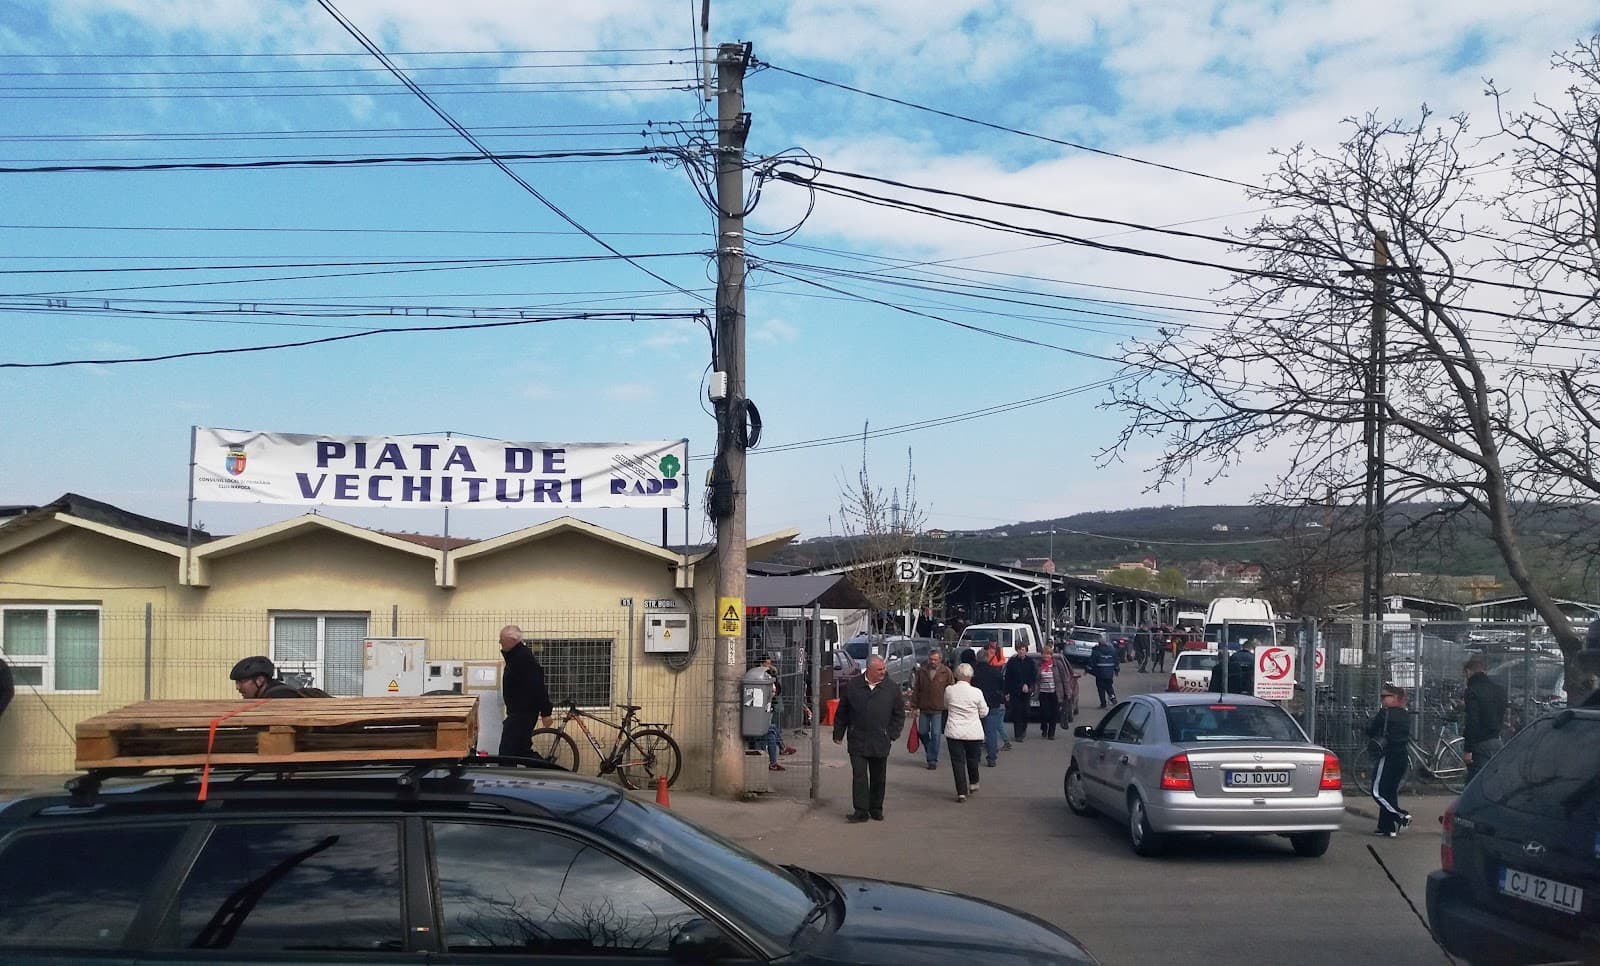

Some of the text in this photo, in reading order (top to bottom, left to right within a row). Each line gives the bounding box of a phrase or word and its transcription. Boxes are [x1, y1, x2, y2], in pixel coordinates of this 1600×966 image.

[316, 441, 566, 473] PIATA DE
[296, 472, 582, 502] VECHITURI
[611, 479, 678, 496] RADP
[901, 561, 914, 579] B
[1234, 773, 1287, 784] CJ 10 VUO
[1511, 873, 1577, 909] CJ 12 LLI
